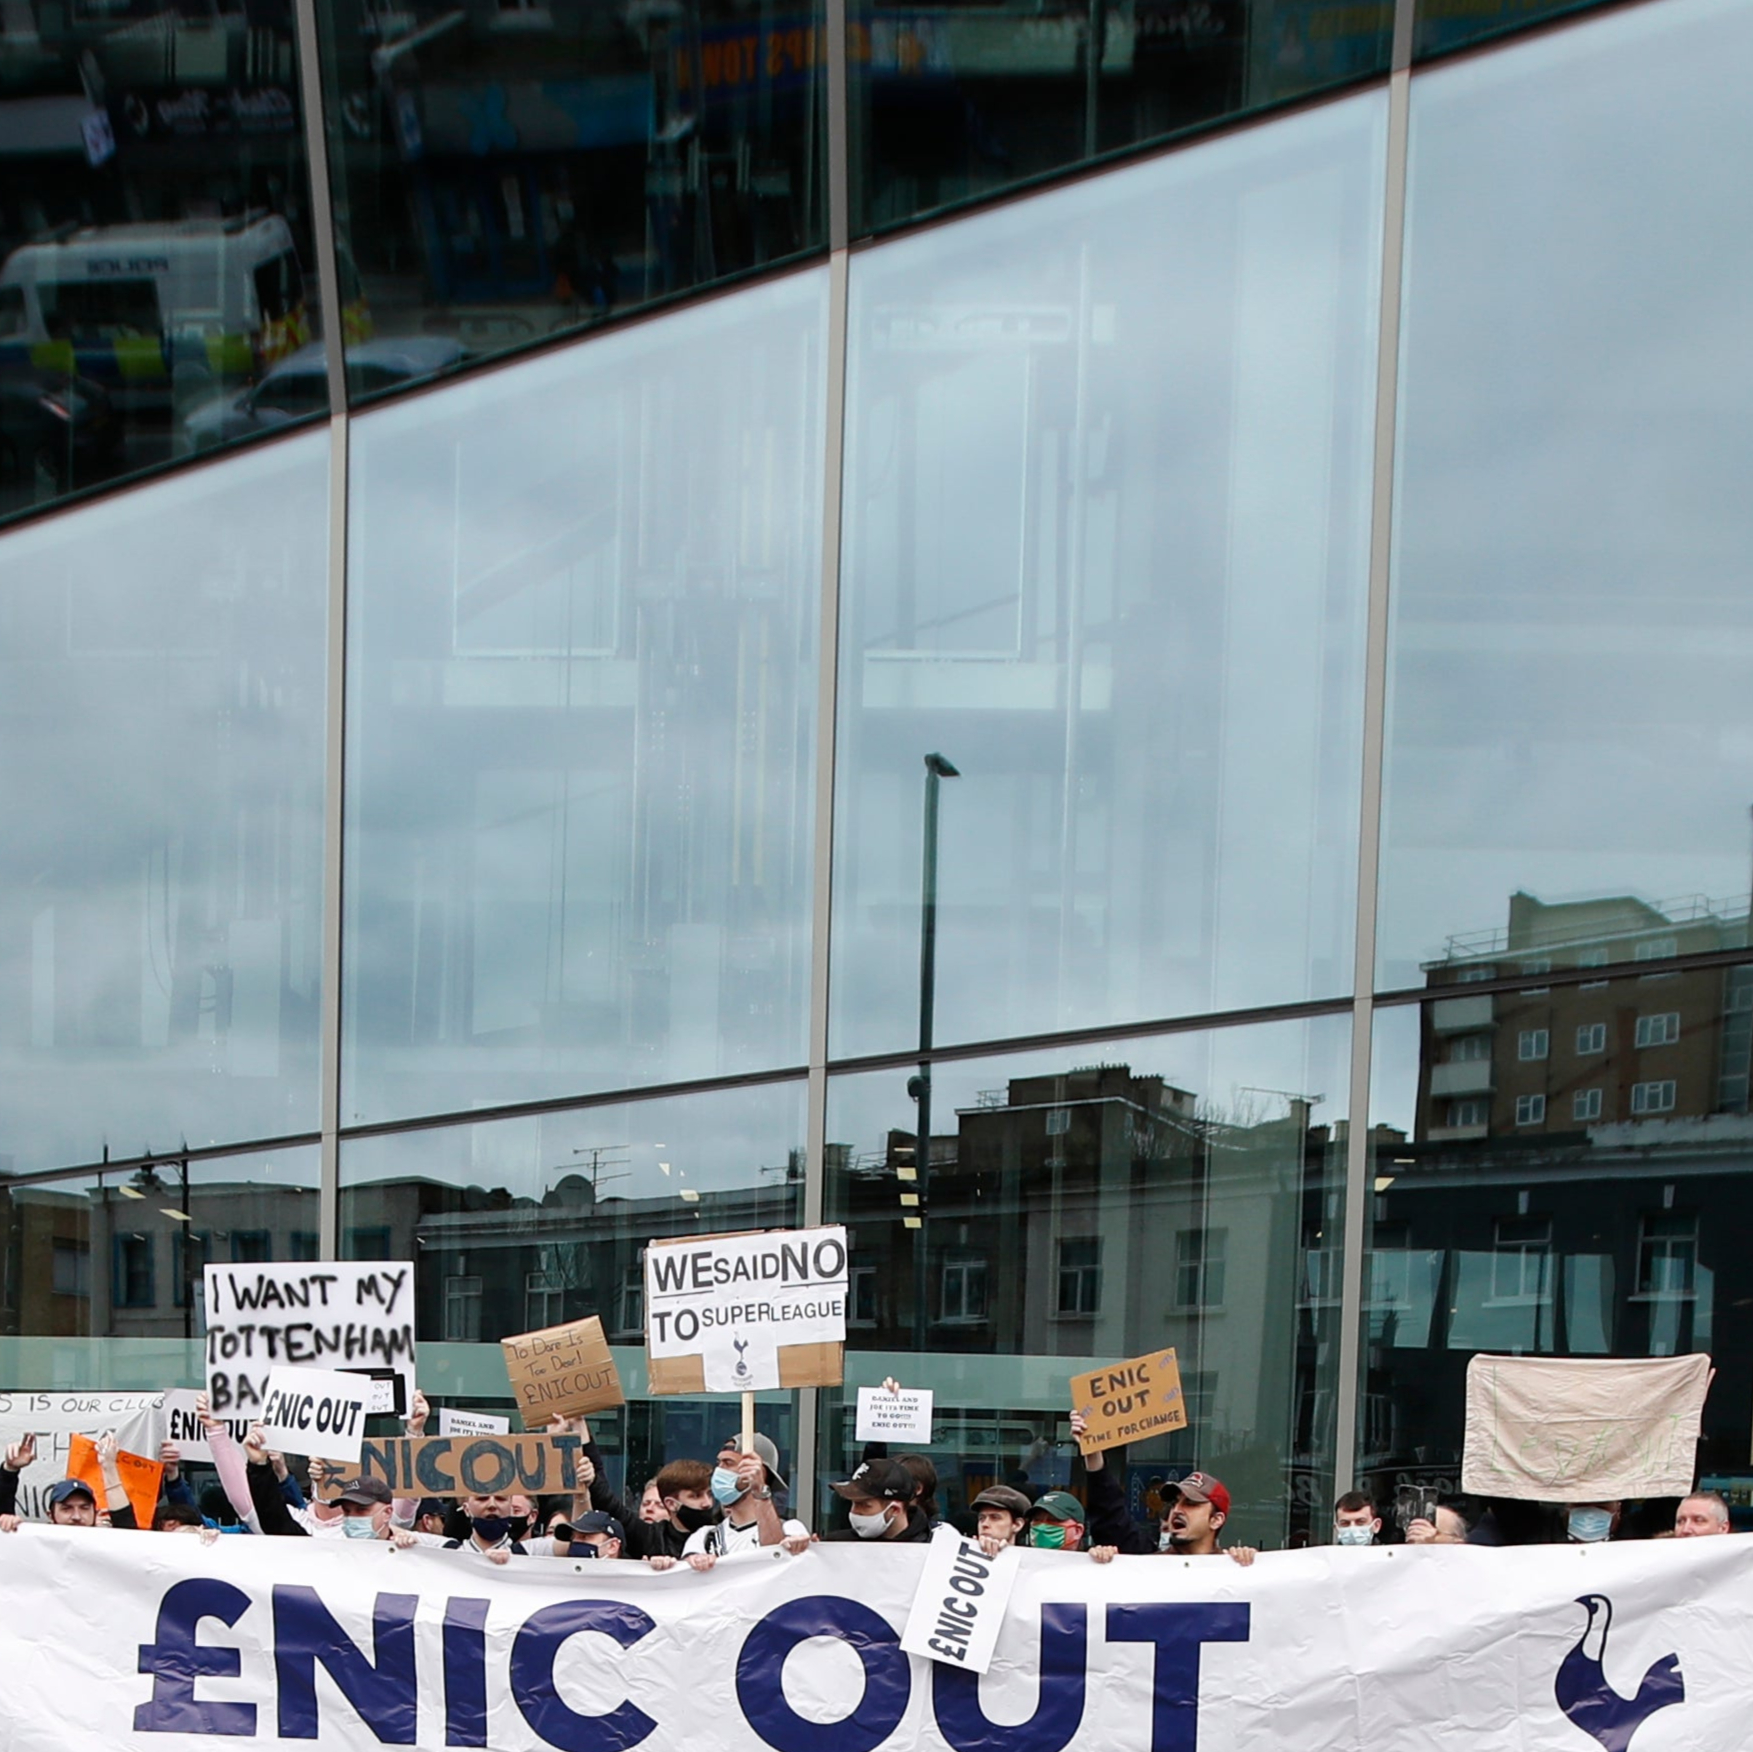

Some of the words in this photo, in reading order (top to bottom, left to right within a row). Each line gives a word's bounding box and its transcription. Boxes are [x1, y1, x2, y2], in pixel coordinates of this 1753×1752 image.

[212, 1273, 219, 1314] I
[228, 1272, 337, 1310] WANT
[356, 1269, 407, 1314] MY
[207, 1323, 415, 1365] TOTTENHAM
[507, 1342, 528, 1359] To
[531, 1337, 561, 1356] Dare
[211, 1372, 270, 1413] BA
[574, 1368, 611, 1392] OUT
[1090, 1363, 1150, 1398] ENIC
[30, 1394, 51, 1412] IS
[61, 1398, 101, 1413] OUR
[109, 1396, 165, 1412] CLUB
[316, 1397, 362, 1437] OUT
[1102, 1389, 1150, 1417] OUT
[1083, 1431, 1111, 1445] TIME
[1118, 1423, 1139, 1437] FOR
[1139, 1410, 1180, 1430] CHANGE
[949, 1541, 995, 1596] OUT
